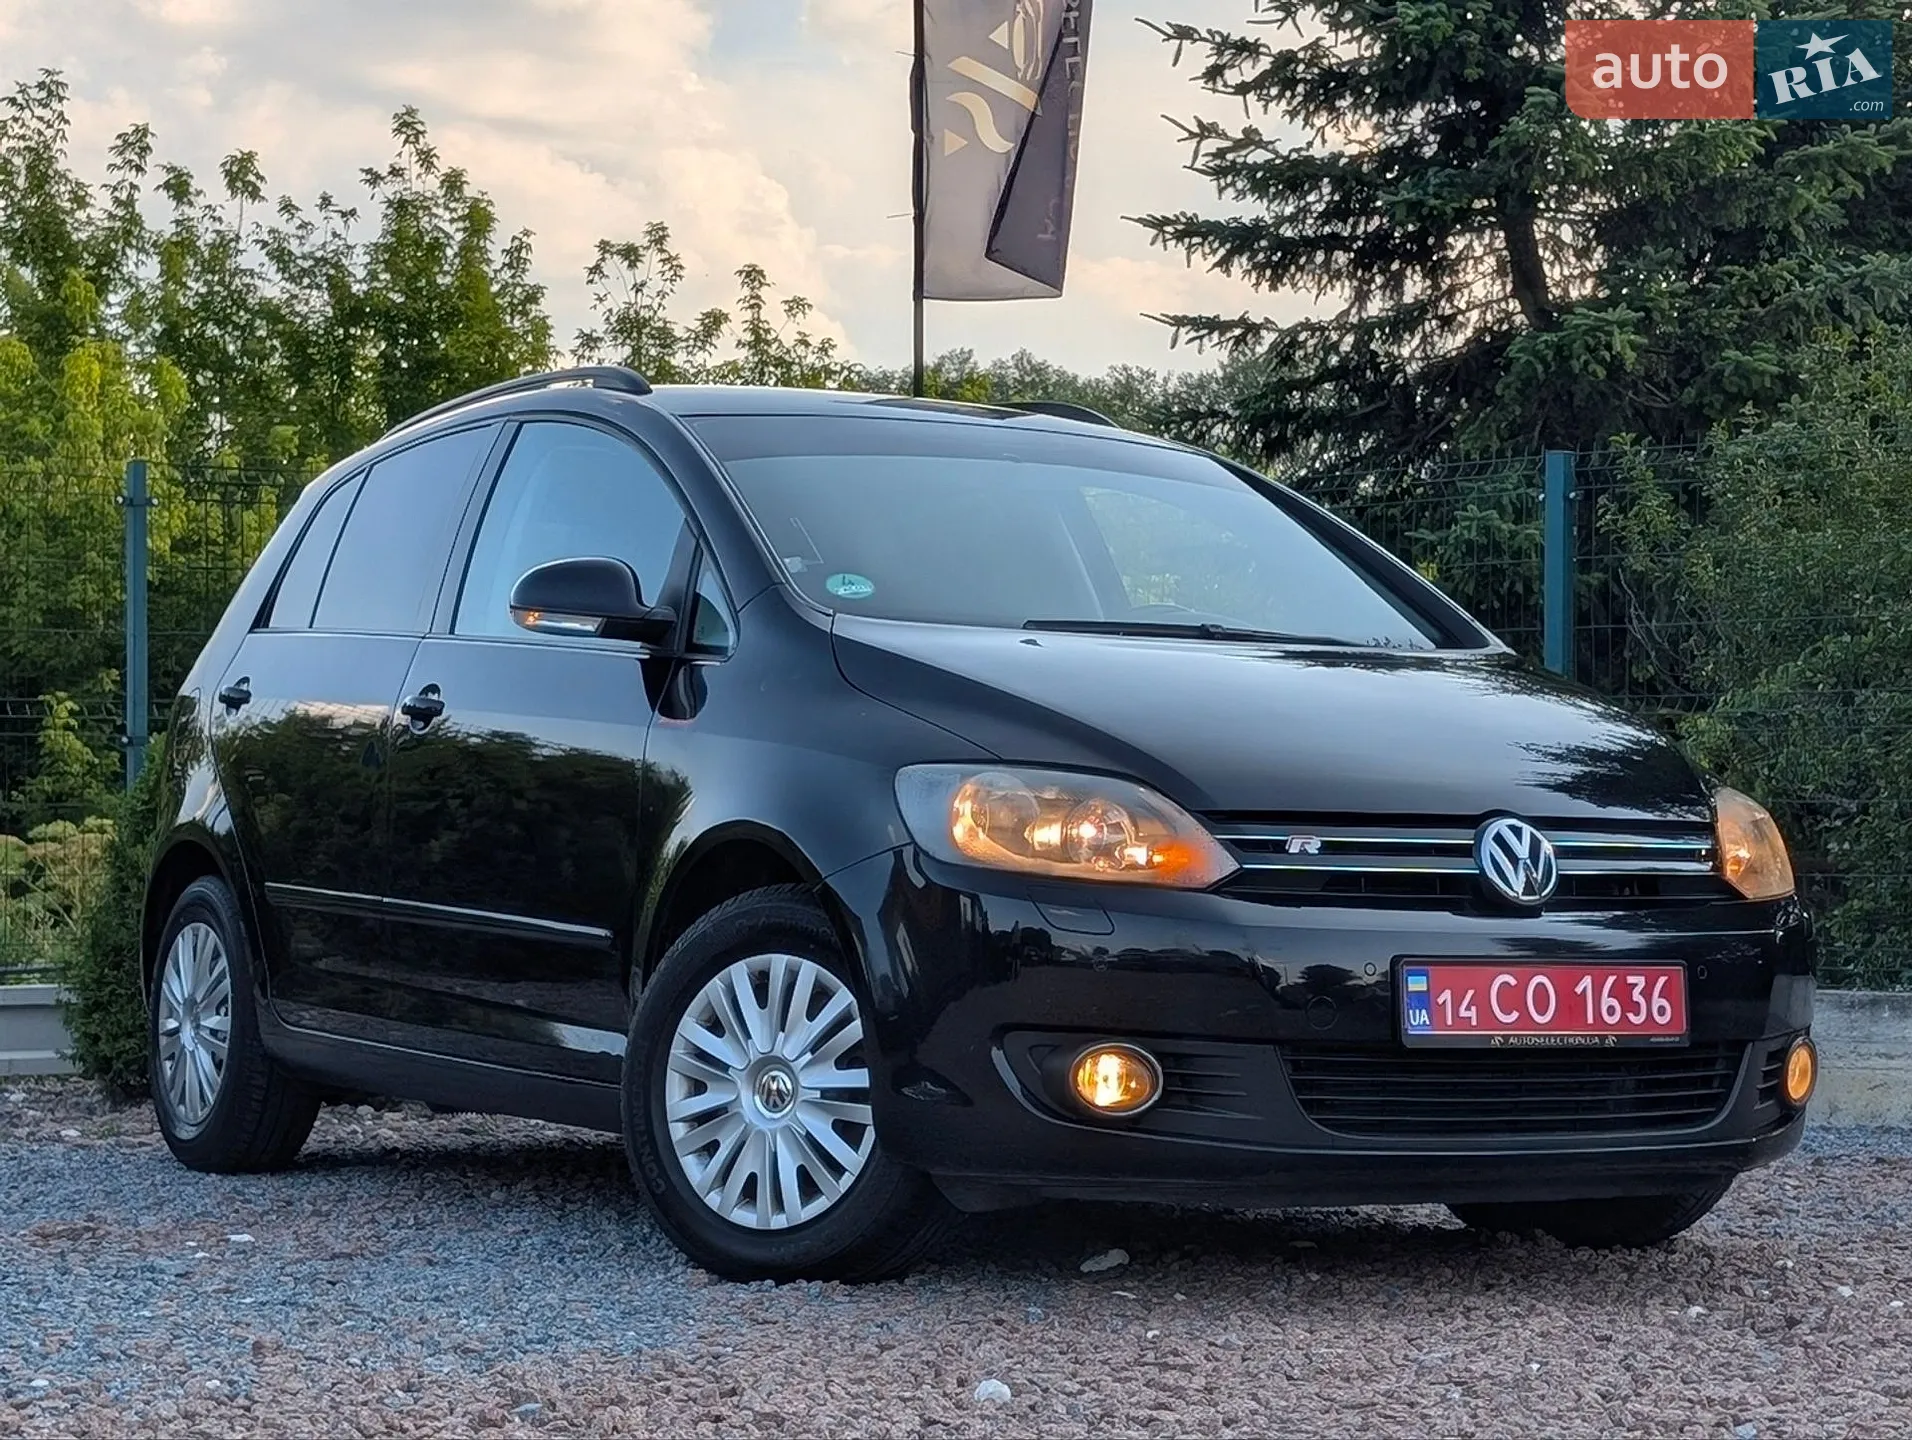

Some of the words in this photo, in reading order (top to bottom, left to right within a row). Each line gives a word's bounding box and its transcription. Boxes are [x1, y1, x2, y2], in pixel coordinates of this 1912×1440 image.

[1285, 835, 1322, 854] R
[1436, 989, 1478, 1026] 14
[1490, 974, 1556, 1024] CO
[1574, 975, 1672, 1025] 1636
[1409, 1009, 1429, 1026] UA
